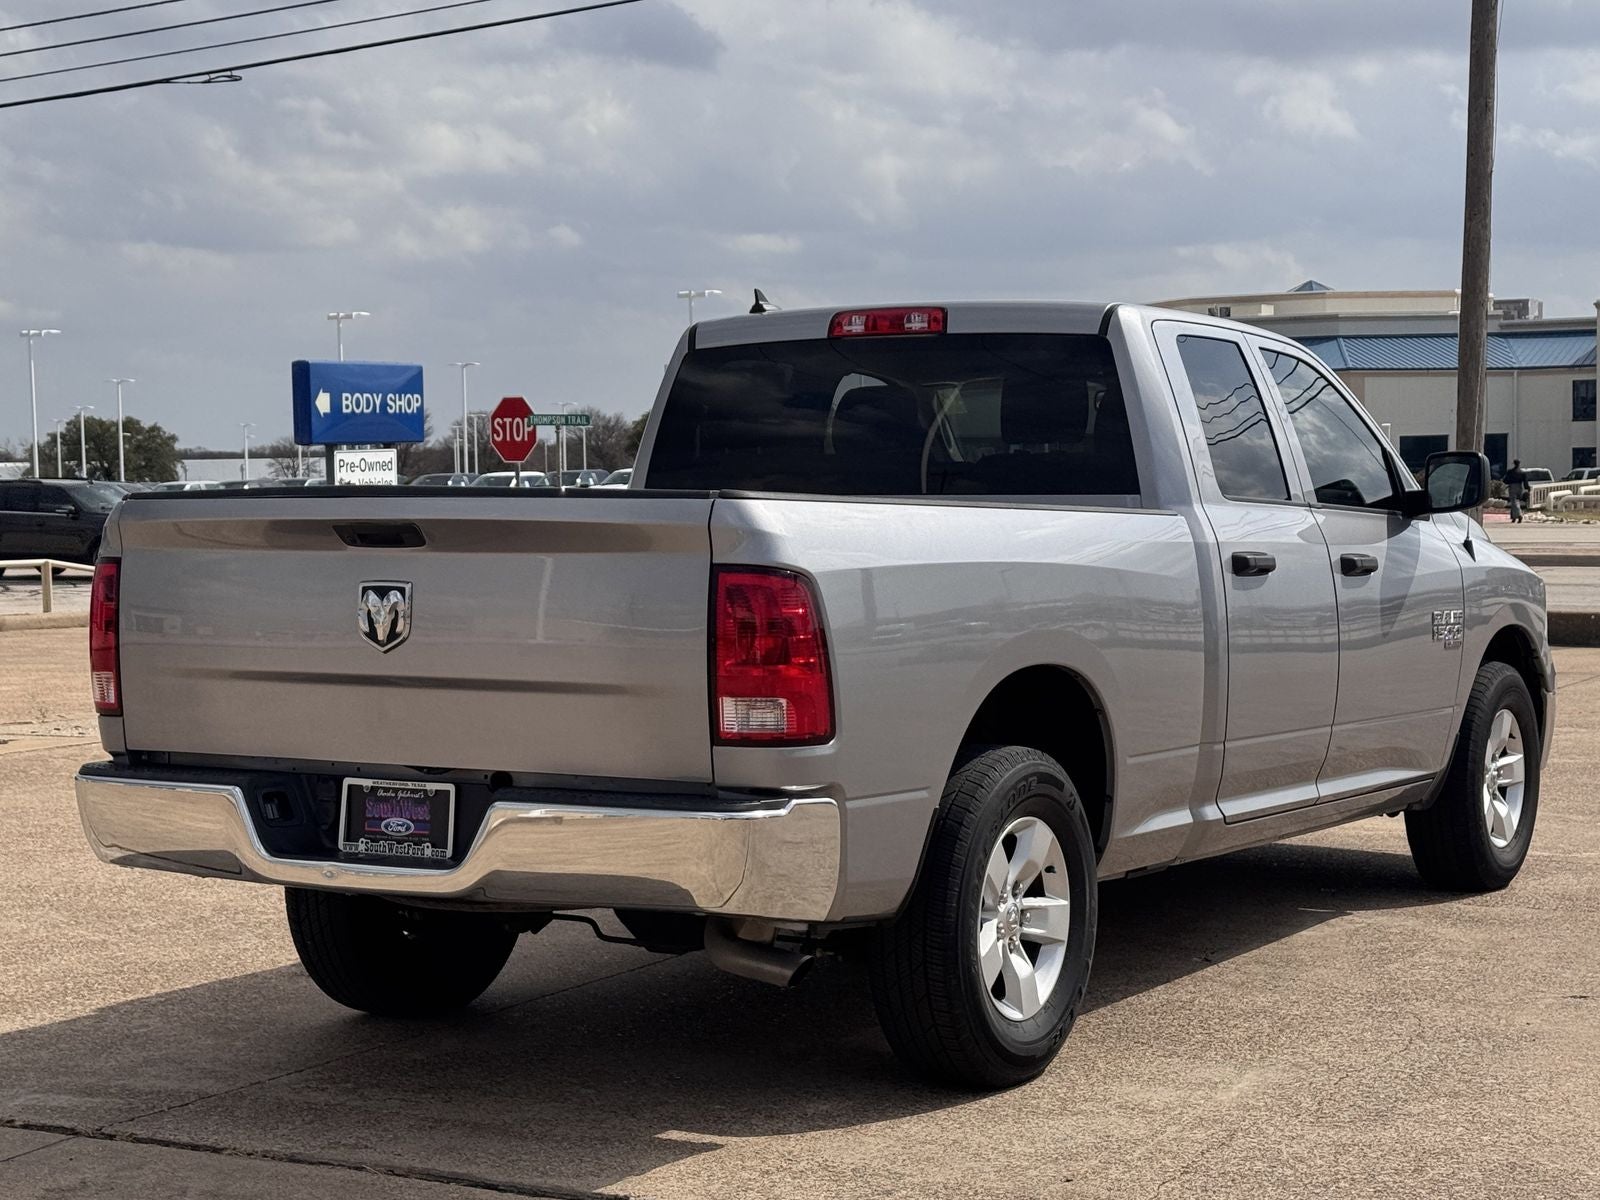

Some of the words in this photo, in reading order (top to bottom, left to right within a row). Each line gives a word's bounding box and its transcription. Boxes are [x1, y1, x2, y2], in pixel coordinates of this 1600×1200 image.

[342, 392, 382, 413] BODY
[386, 393, 421, 413] SHOP
[530, 415, 566, 425] THOMPSON
[568, 415, 588, 425] TRAIL
[493, 417, 534, 442] STOP
[338, 457, 393, 473] Pre-Owned
[387, 820, 407, 832] Ford
